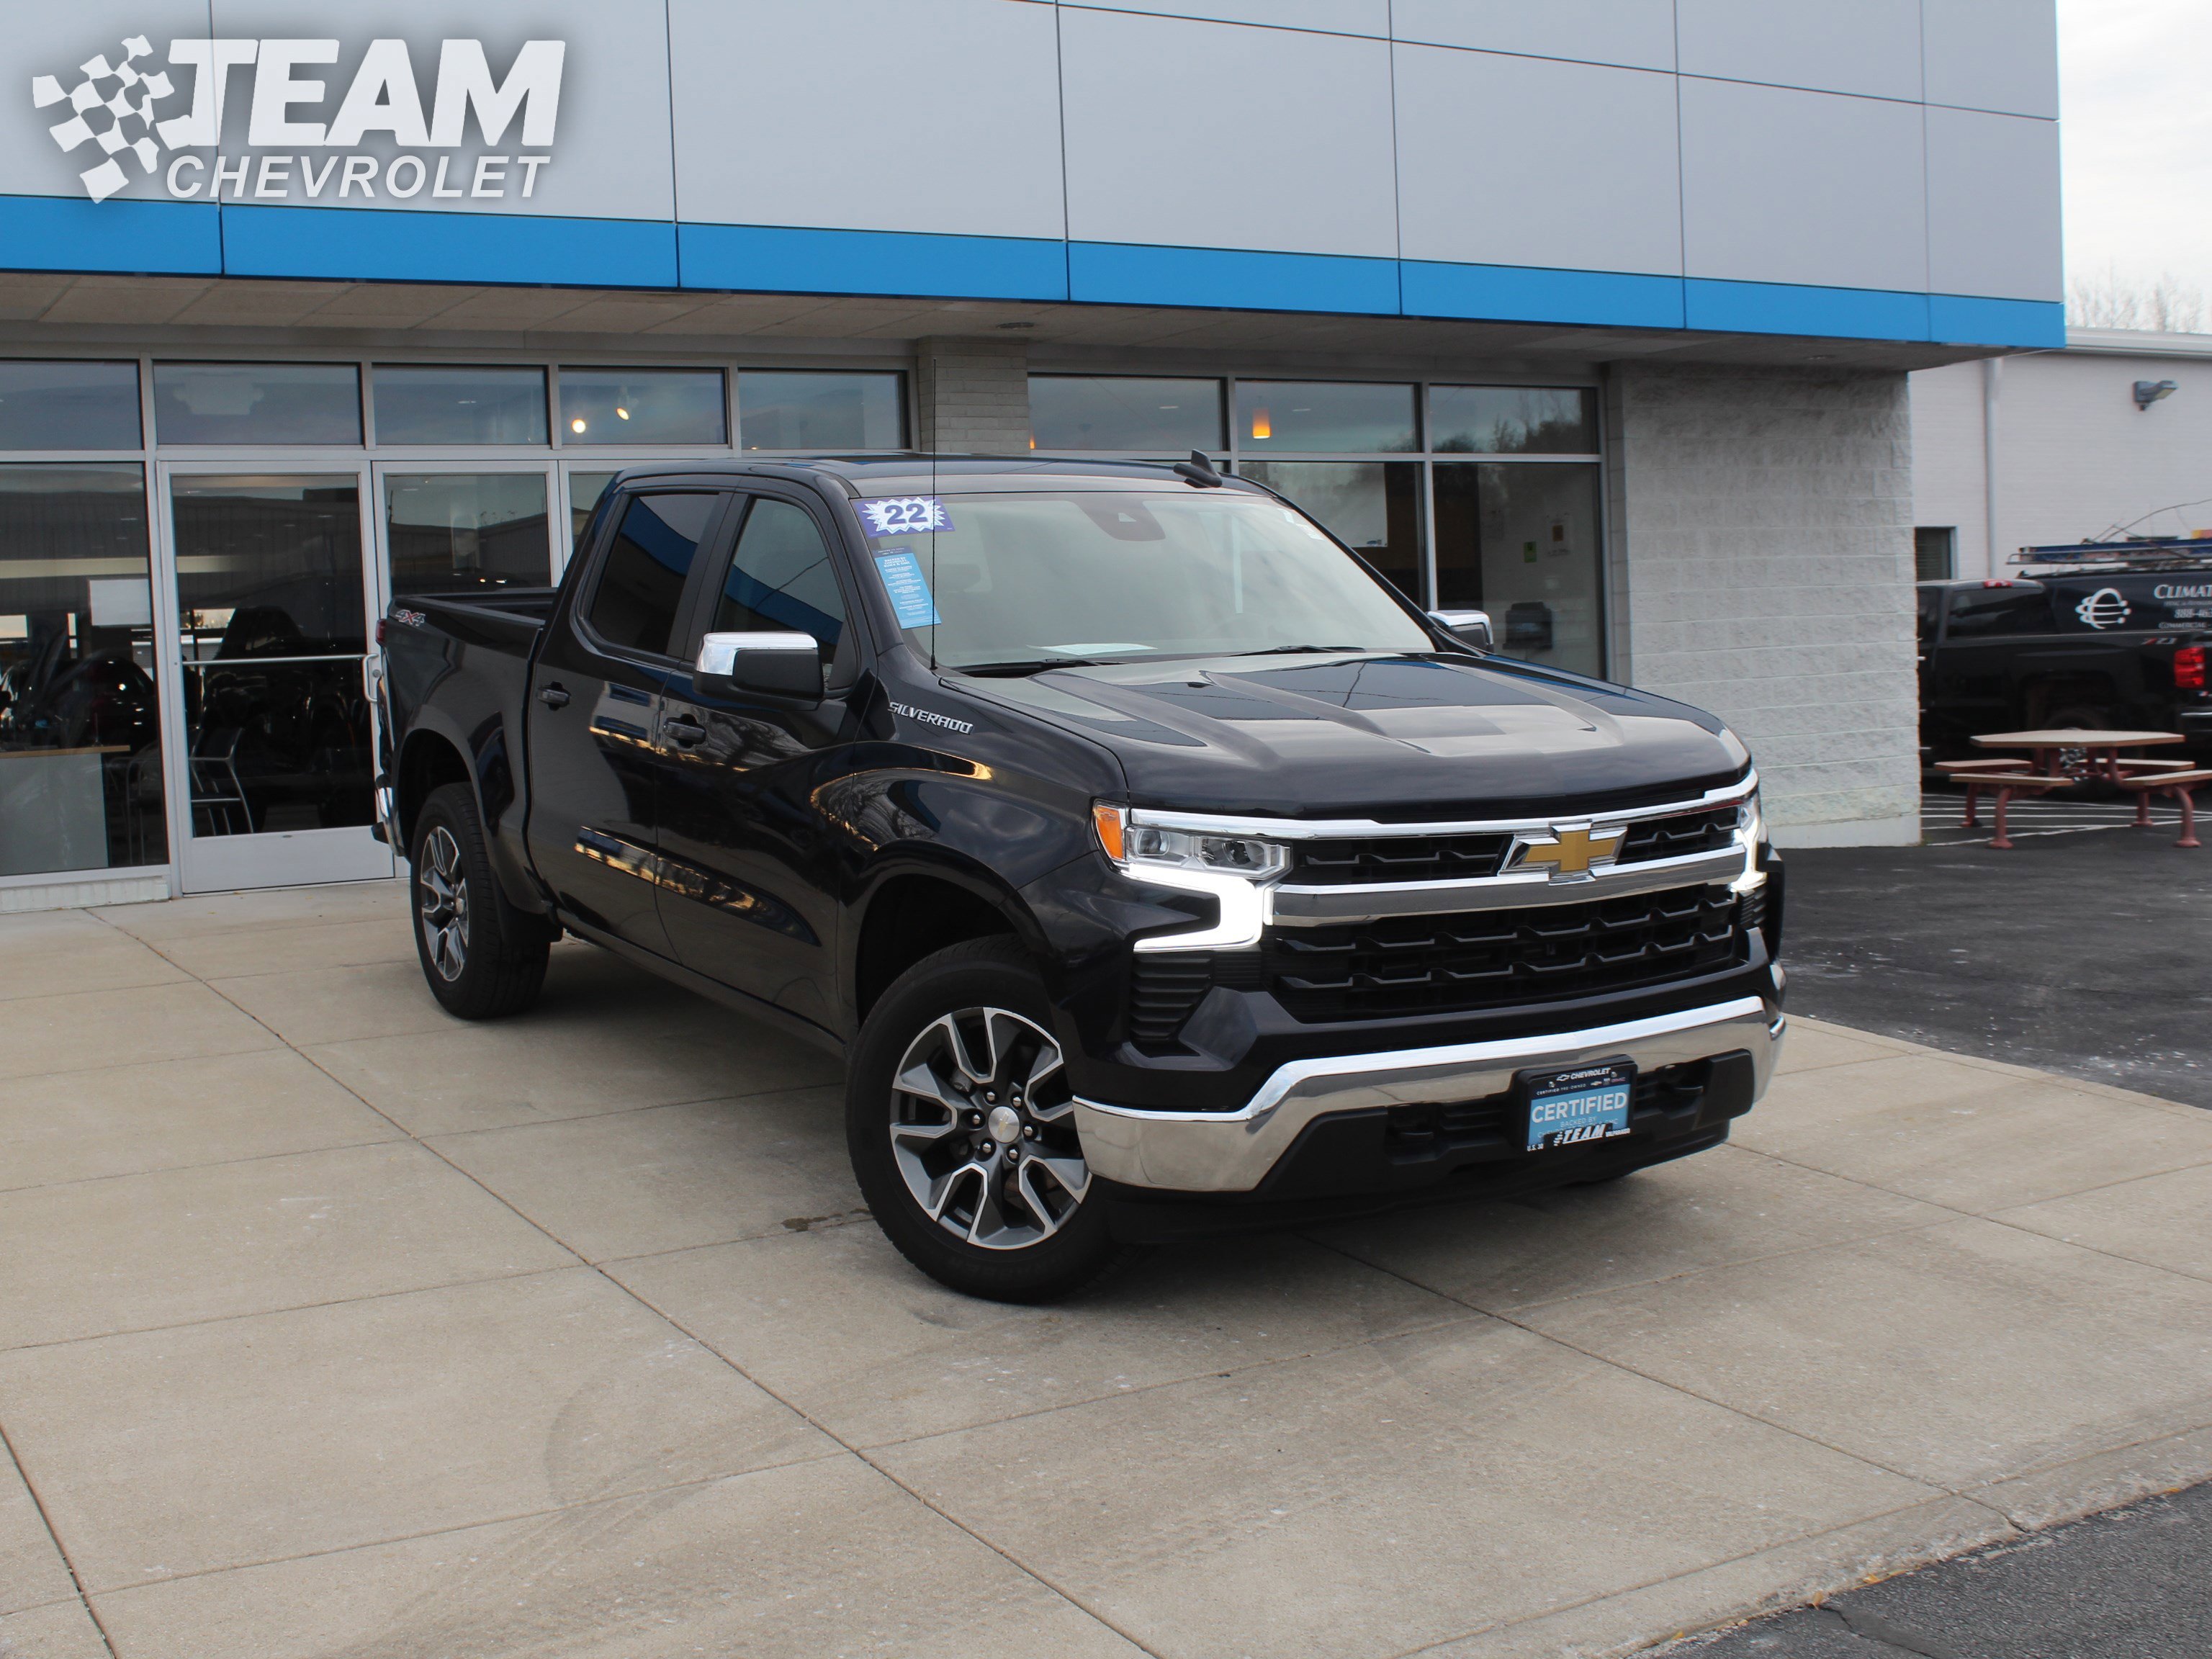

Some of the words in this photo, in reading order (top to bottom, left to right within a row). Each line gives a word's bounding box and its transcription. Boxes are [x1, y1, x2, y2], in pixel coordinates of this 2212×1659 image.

[884, 503, 928, 525] 22
[888, 701, 974, 734] SILVERADO
[1570, 1067, 1611, 1080] CHEVROLET
[1532, 1092, 1628, 1123] CERTIFIED
[1563, 1123, 1606, 1142] TEAM
